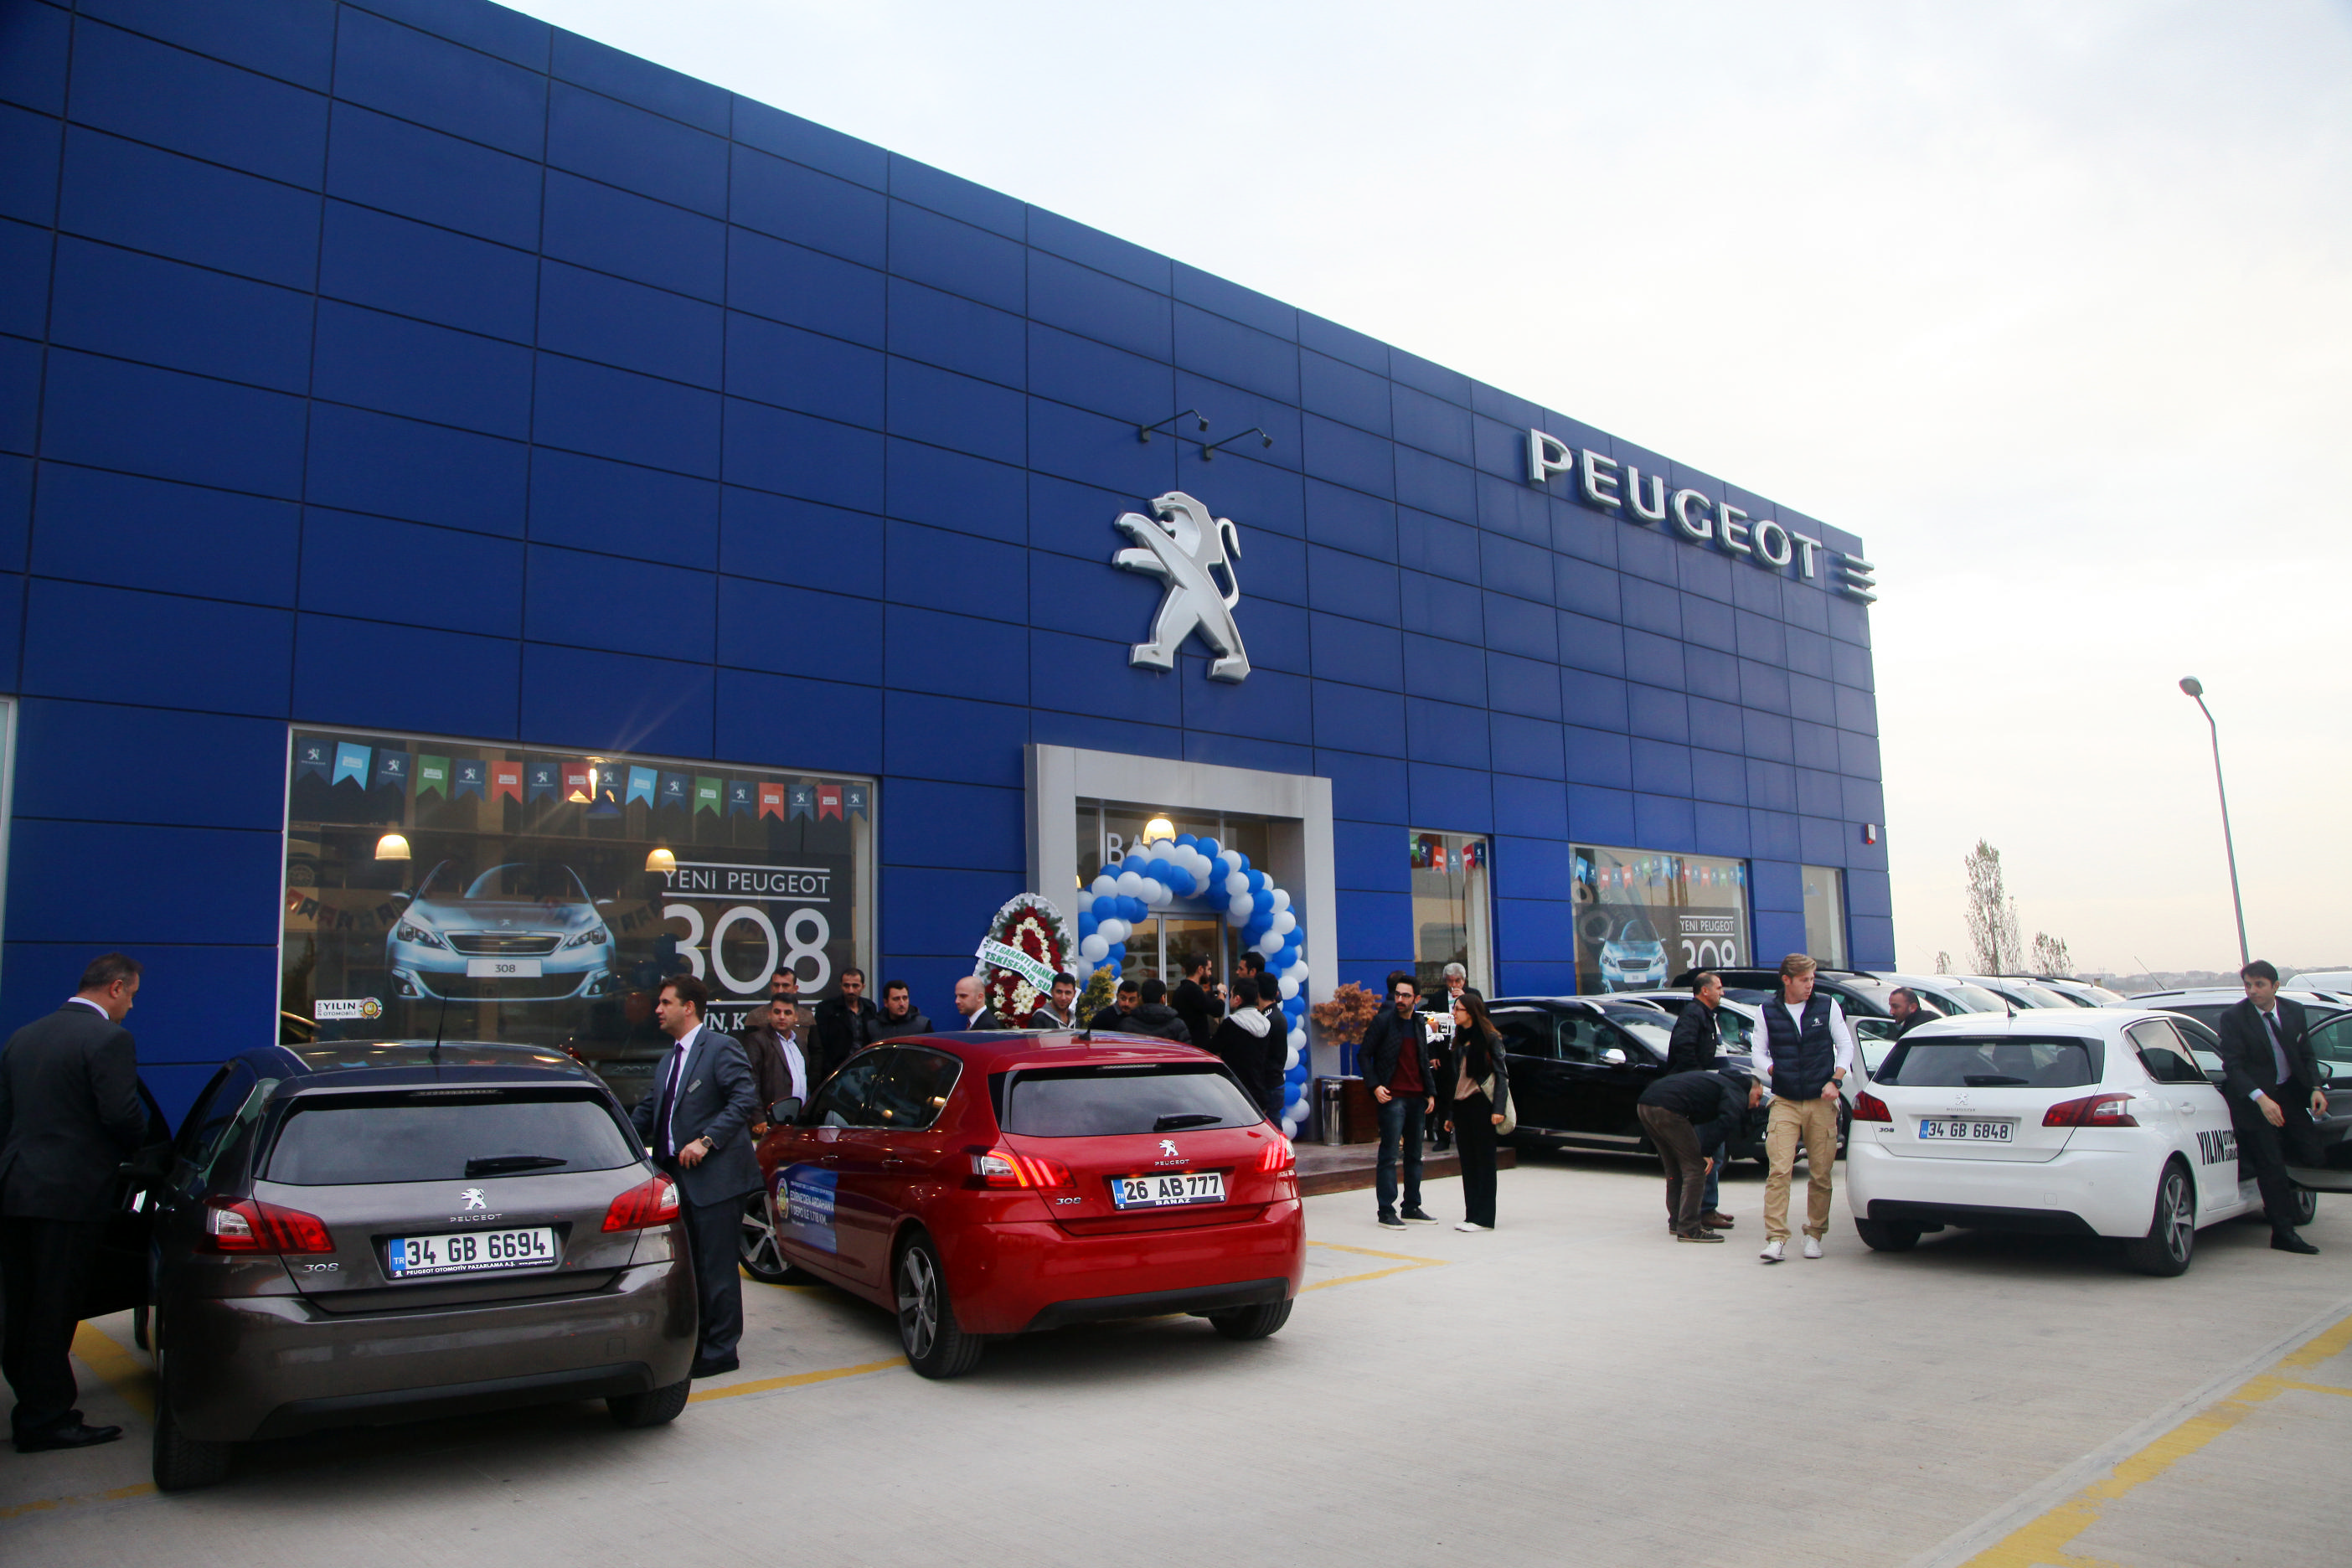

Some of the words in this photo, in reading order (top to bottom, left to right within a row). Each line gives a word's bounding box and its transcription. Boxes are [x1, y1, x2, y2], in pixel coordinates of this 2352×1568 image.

[1529, 428, 1823, 580] PEUGEOT
[663, 869, 716, 890] YENİ
[727, 871, 831, 895] PEUGEOT
[1700, 920, 1735, 932] PEUGEOT
[662, 903, 832, 994] 308
[1681, 939, 1736, 969] 308
[495, 964, 516, 973] 308
[1030, 963, 1056, 983] BANKA
[323, 1002, 356, 1010] YILIN
[1928, 1122, 1944, 1137] 34
[1950, 1122, 1968, 1137] GB
[1973, 1123, 2009, 1139] 6848
[2196, 1129, 2225, 1166] YILIN
[1154, 1158, 1190, 1167] PEUGEOT
[1123, 1180, 1148, 1200] 26
[1158, 1178, 1184, 1198] AB
[1186, 1175, 1220, 1196] 777
[1055, 1197, 1082, 1205] 308
[1154, 1198, 1191, 1206] BANAZ
[450, 1213, 503, 1223] PEUGEOT
[406, 1240, 436, 1266] 34
[447, 1236, 477, 1262] GB
[487, 1231, 546, 1259] 6694
[394, 1256, 405, 1265] TR
[302, 1262, 339, 1273] 308
[435, 1264, 467, 1273] OTOMOTİV
[467, 1261, 504, 1271] PAZARLAMA
